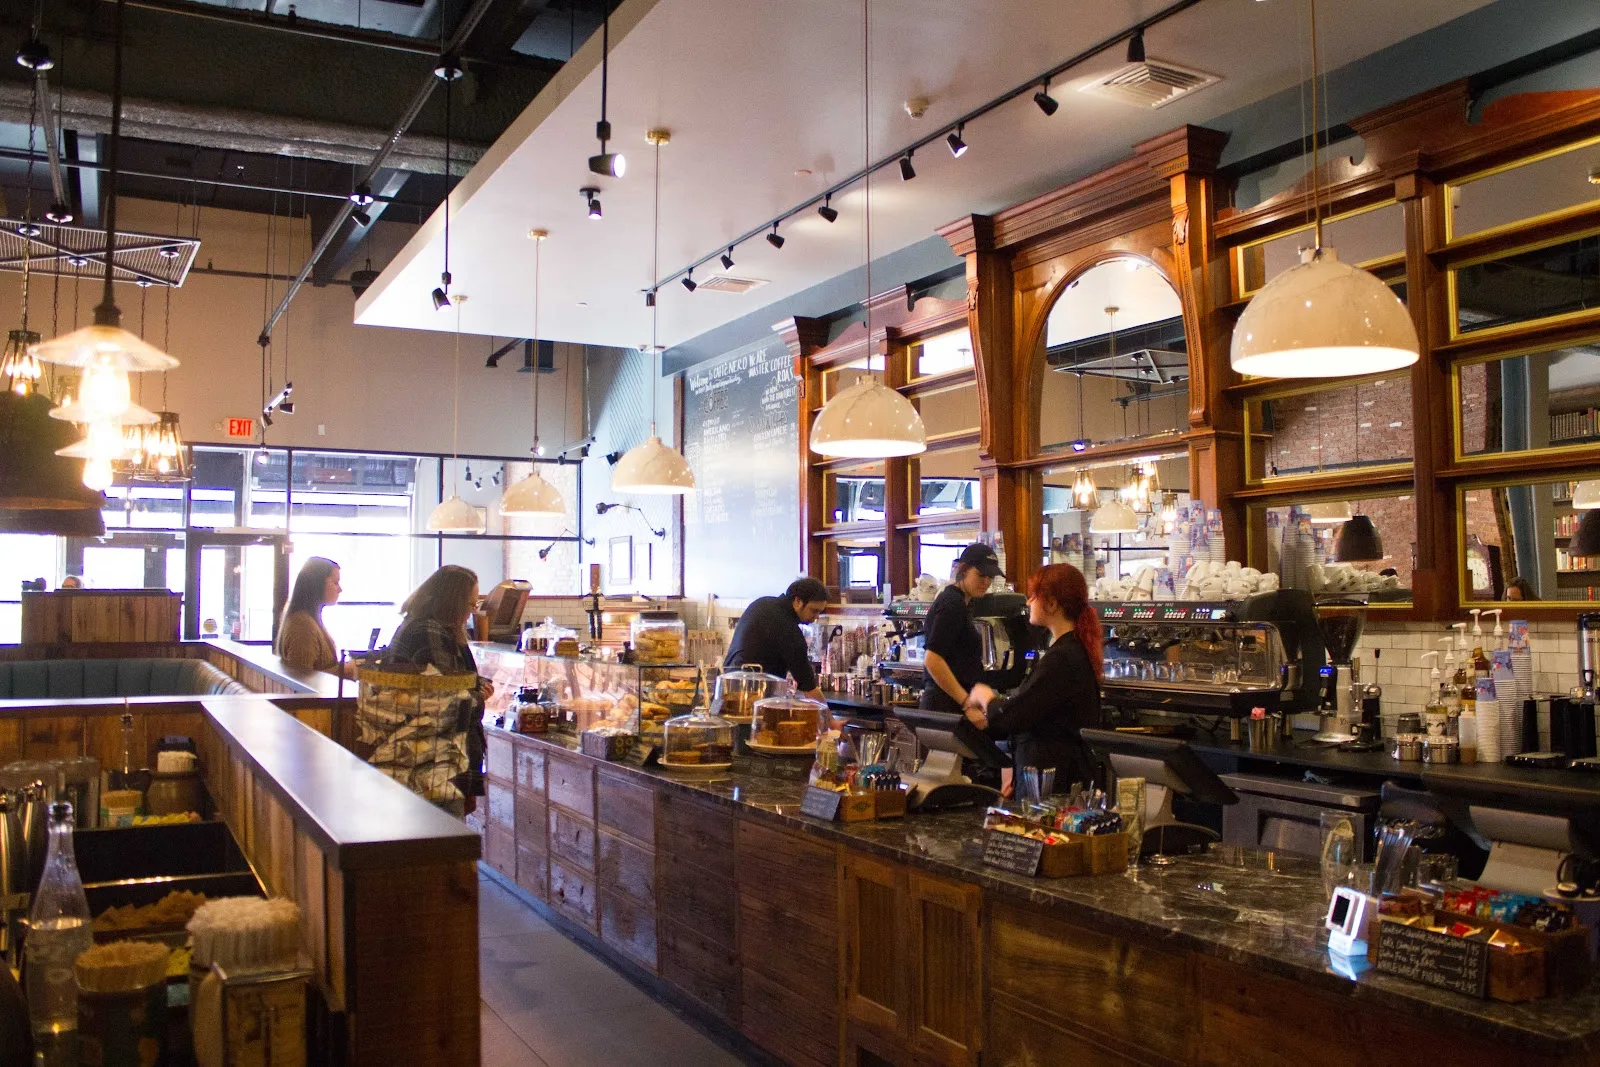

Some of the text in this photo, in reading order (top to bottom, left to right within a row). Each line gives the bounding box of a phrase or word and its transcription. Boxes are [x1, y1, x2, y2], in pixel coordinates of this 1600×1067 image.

[728, 356, 748, 375] NERO
[770, 354, 792, 372] COFFEE
[229, 419, 252, 436] EXIT
[703, 423, 731, 436] AMERICANO
